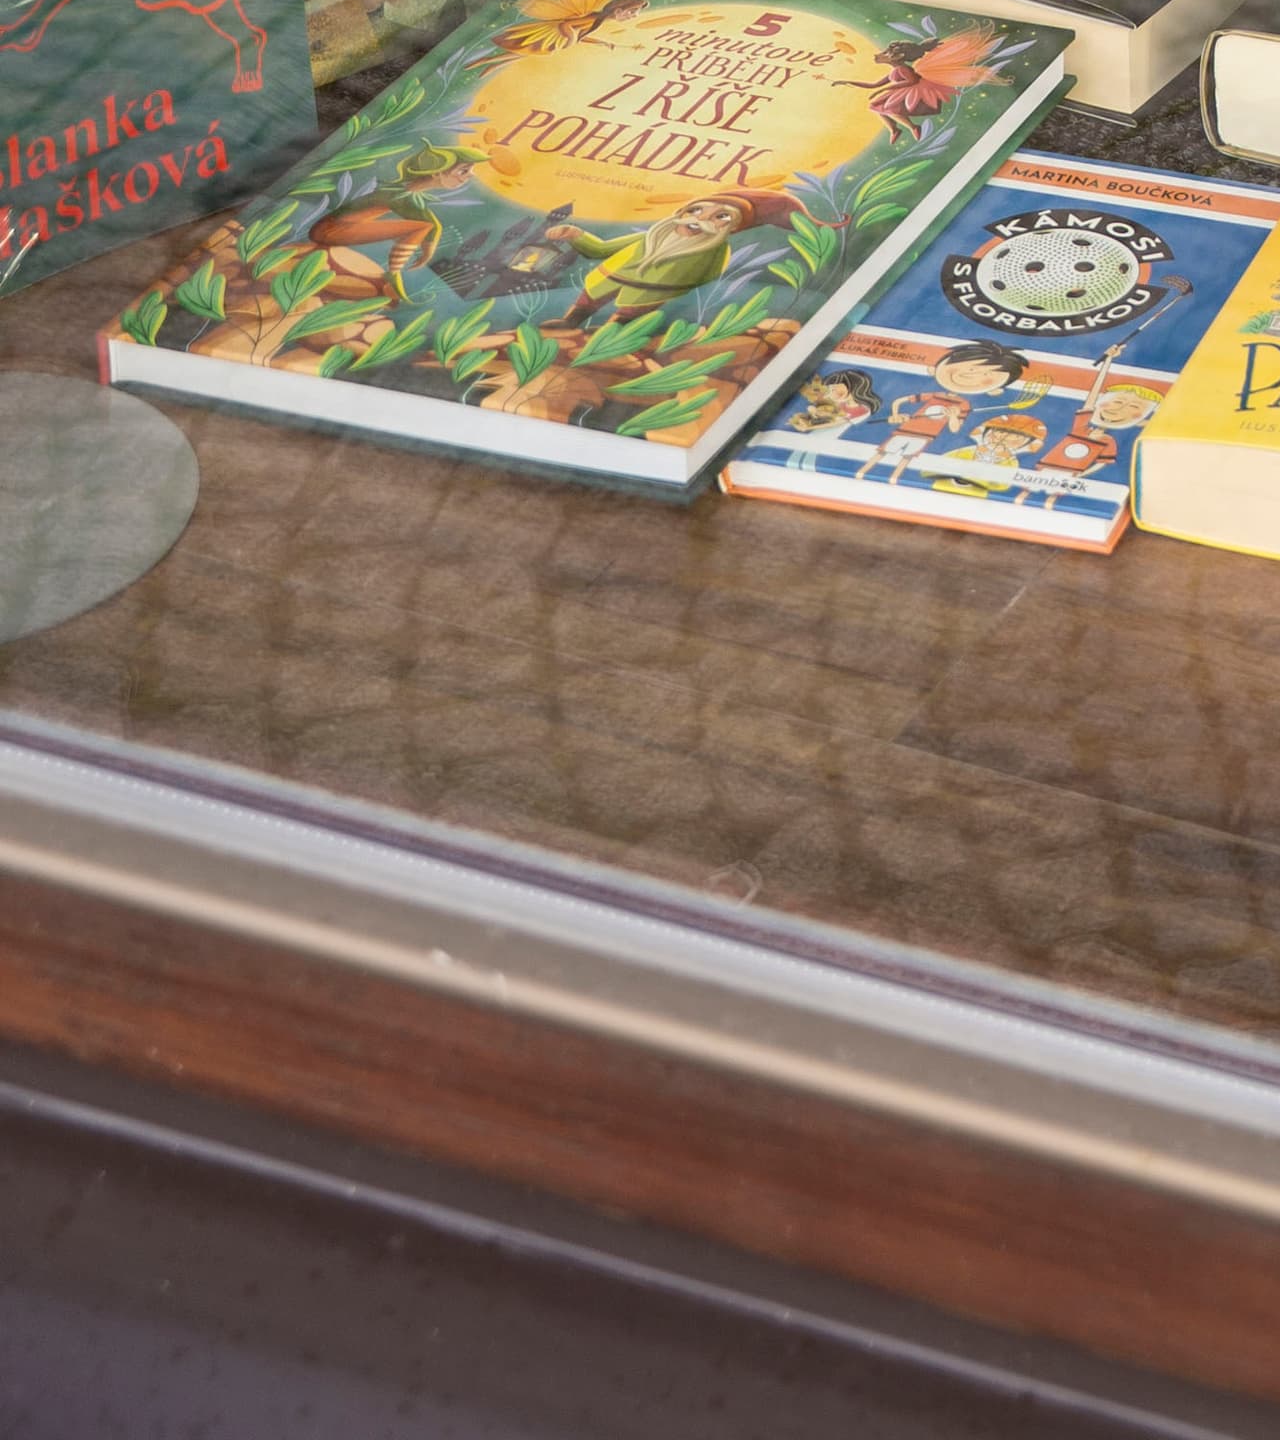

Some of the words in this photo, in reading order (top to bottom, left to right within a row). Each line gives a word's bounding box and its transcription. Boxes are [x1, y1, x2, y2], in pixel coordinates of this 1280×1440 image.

[656, 26, 838, 68] minutové
[743, 12, 793, 36] 5
[643, 43, 806, 89] PŘÍBĚHY
[588, 74, 633, 109] Z
[632, 76, 775, 135] ŘÍŠE
[496, 109, 776, 188] POHÁDEK
[1010, 165, 1101, 190] MARTINA
[1105, 178, 1214, 208] BOUČKOVÁ
[994, 209, 1166, 264] KÁMOŠI
[952, 278, 1152, 333] FLORBALKOU
